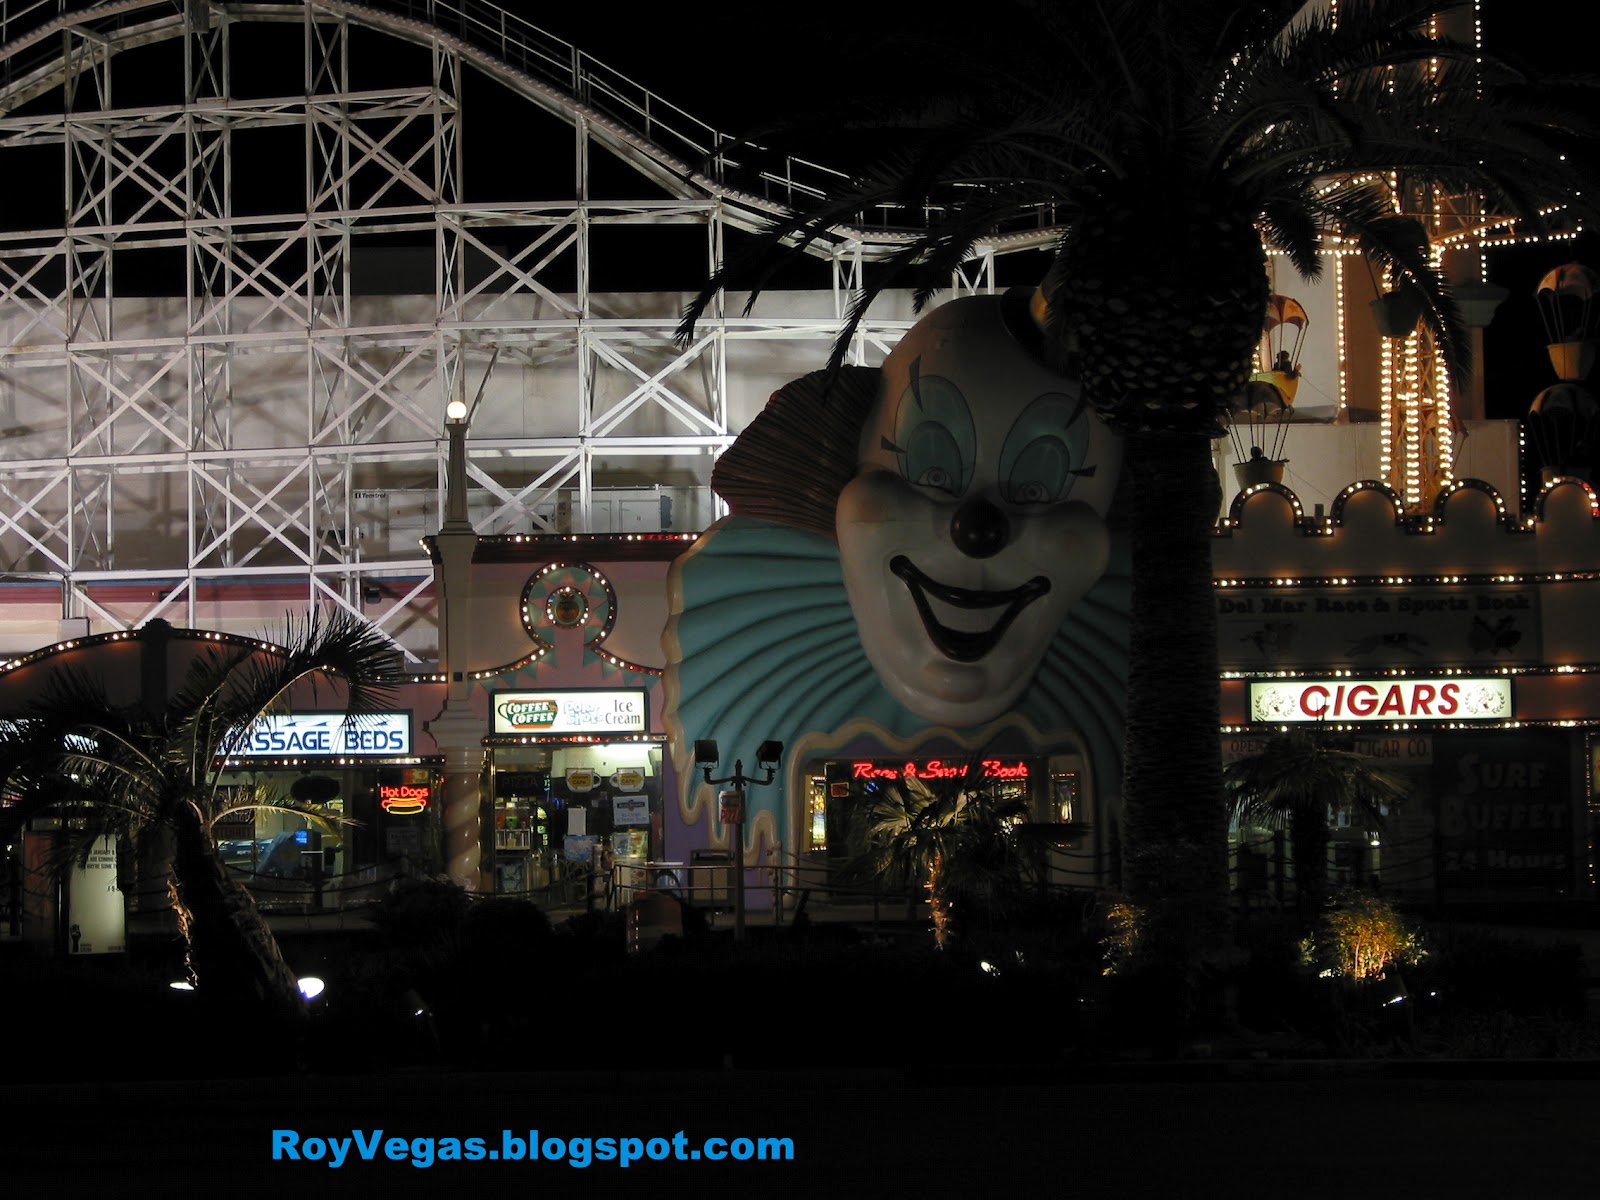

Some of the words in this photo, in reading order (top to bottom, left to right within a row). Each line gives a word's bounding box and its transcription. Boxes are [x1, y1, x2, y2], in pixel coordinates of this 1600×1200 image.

[614, 699, 633, 712] Ice
[1299, 683, 1461, 717] CIGARS
[507, 702, 549, 714] COFFEE
[511, 712, 554, 725] COFFEE
[605, 712, 641, 724] Cream
[344, 730, 404, 750] BEDS
[982, 760, 1029, 778] Book
[380, 785, 400, 798] Hot
[401, 785, 429, 799] Dogs
